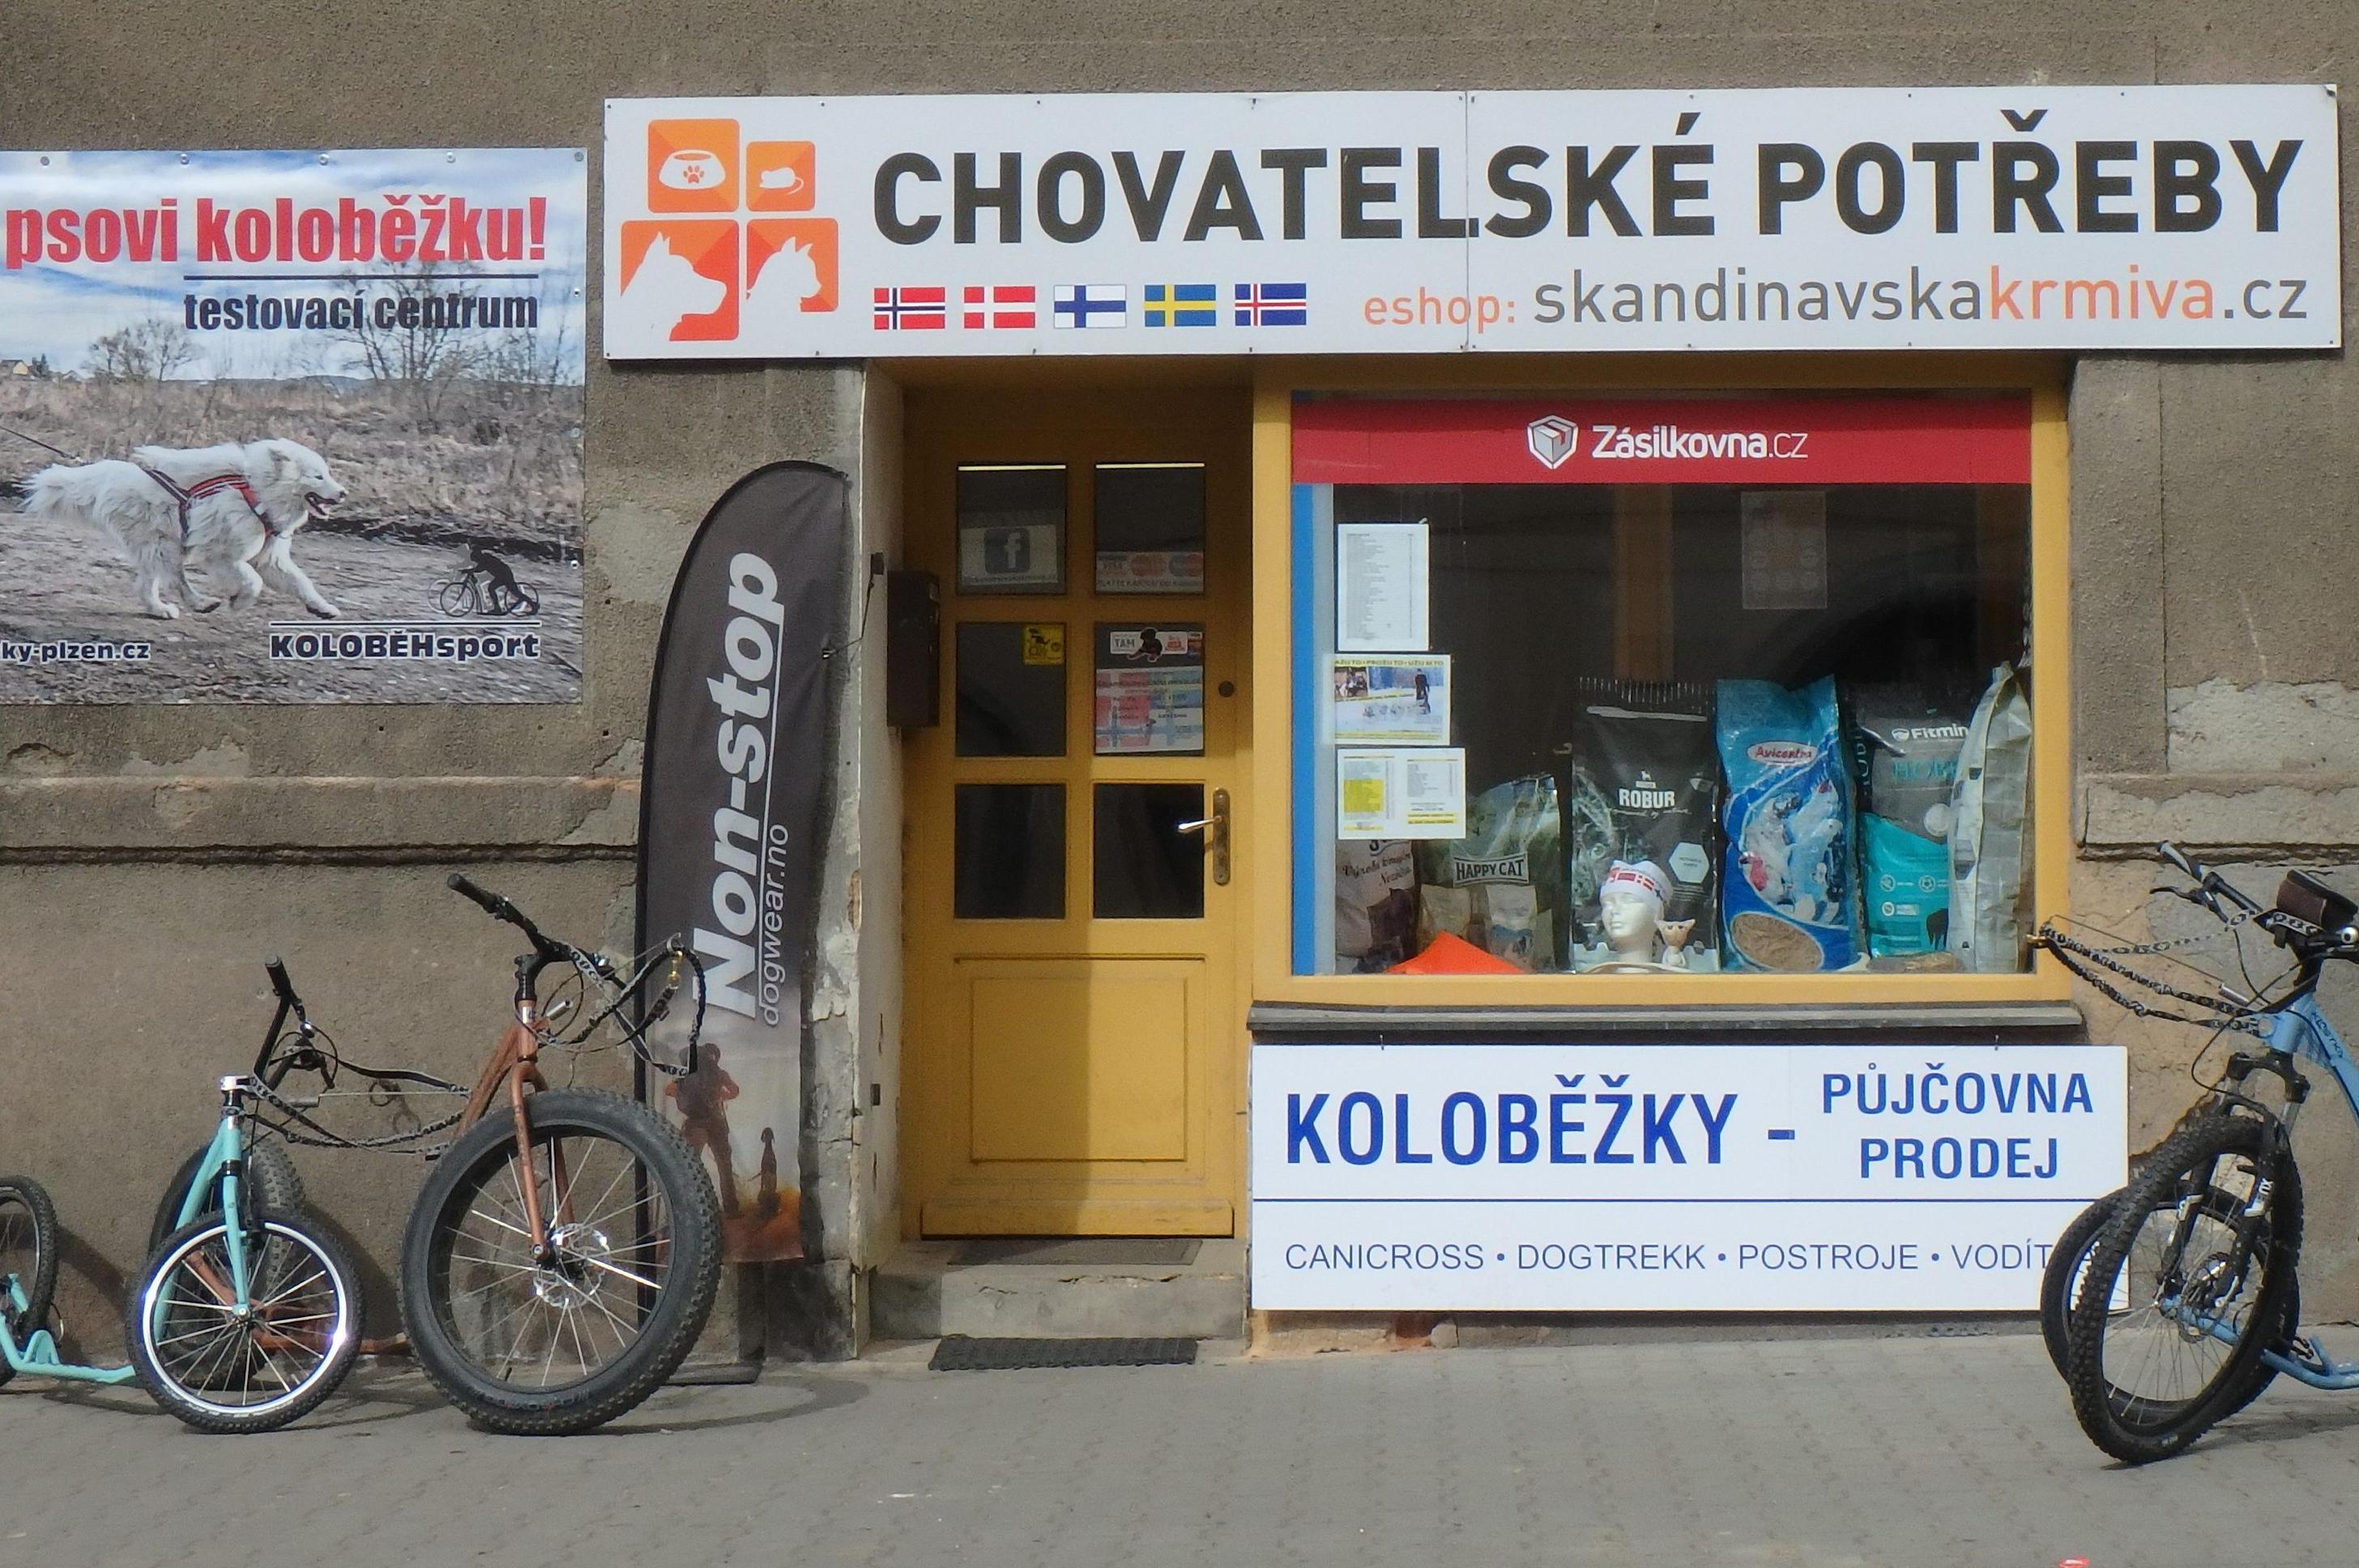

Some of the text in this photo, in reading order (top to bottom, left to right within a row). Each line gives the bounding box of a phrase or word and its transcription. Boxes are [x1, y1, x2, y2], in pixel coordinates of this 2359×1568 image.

[874, 109, 2304, 245] CHOVATELSKÉ POTŘEBY
[5, 194, 548, 270] psovi koloběžku!
[184, 289, 537, 330] testovací centrum
[1364, 265, 2307, 333] eshop: skandinavskakrmiva.cz
[1592, 424, 1809, 459] Zásilkovna.cz
[270, 632, 540, 661] KOLOBĚHsport
[693, 552, 784, 1018] Non-stop
[1618, 788, 1675, 809] ROBUR
[1455, 859, 1525, 882] HAPPY CAT
[764, 823, 789, 1026] dogwear.no
[1822, 1062, 2094, 1114] PŮJČOVNA
[1286, 1074, 1738, 1165] KOLOBĚŽKY
[1860, 1138, 2058, 1179] PRODEJ
[1286, 1238, 2053, 1270] CANICROSS DOGTREKK POSTROJE VODÍT
